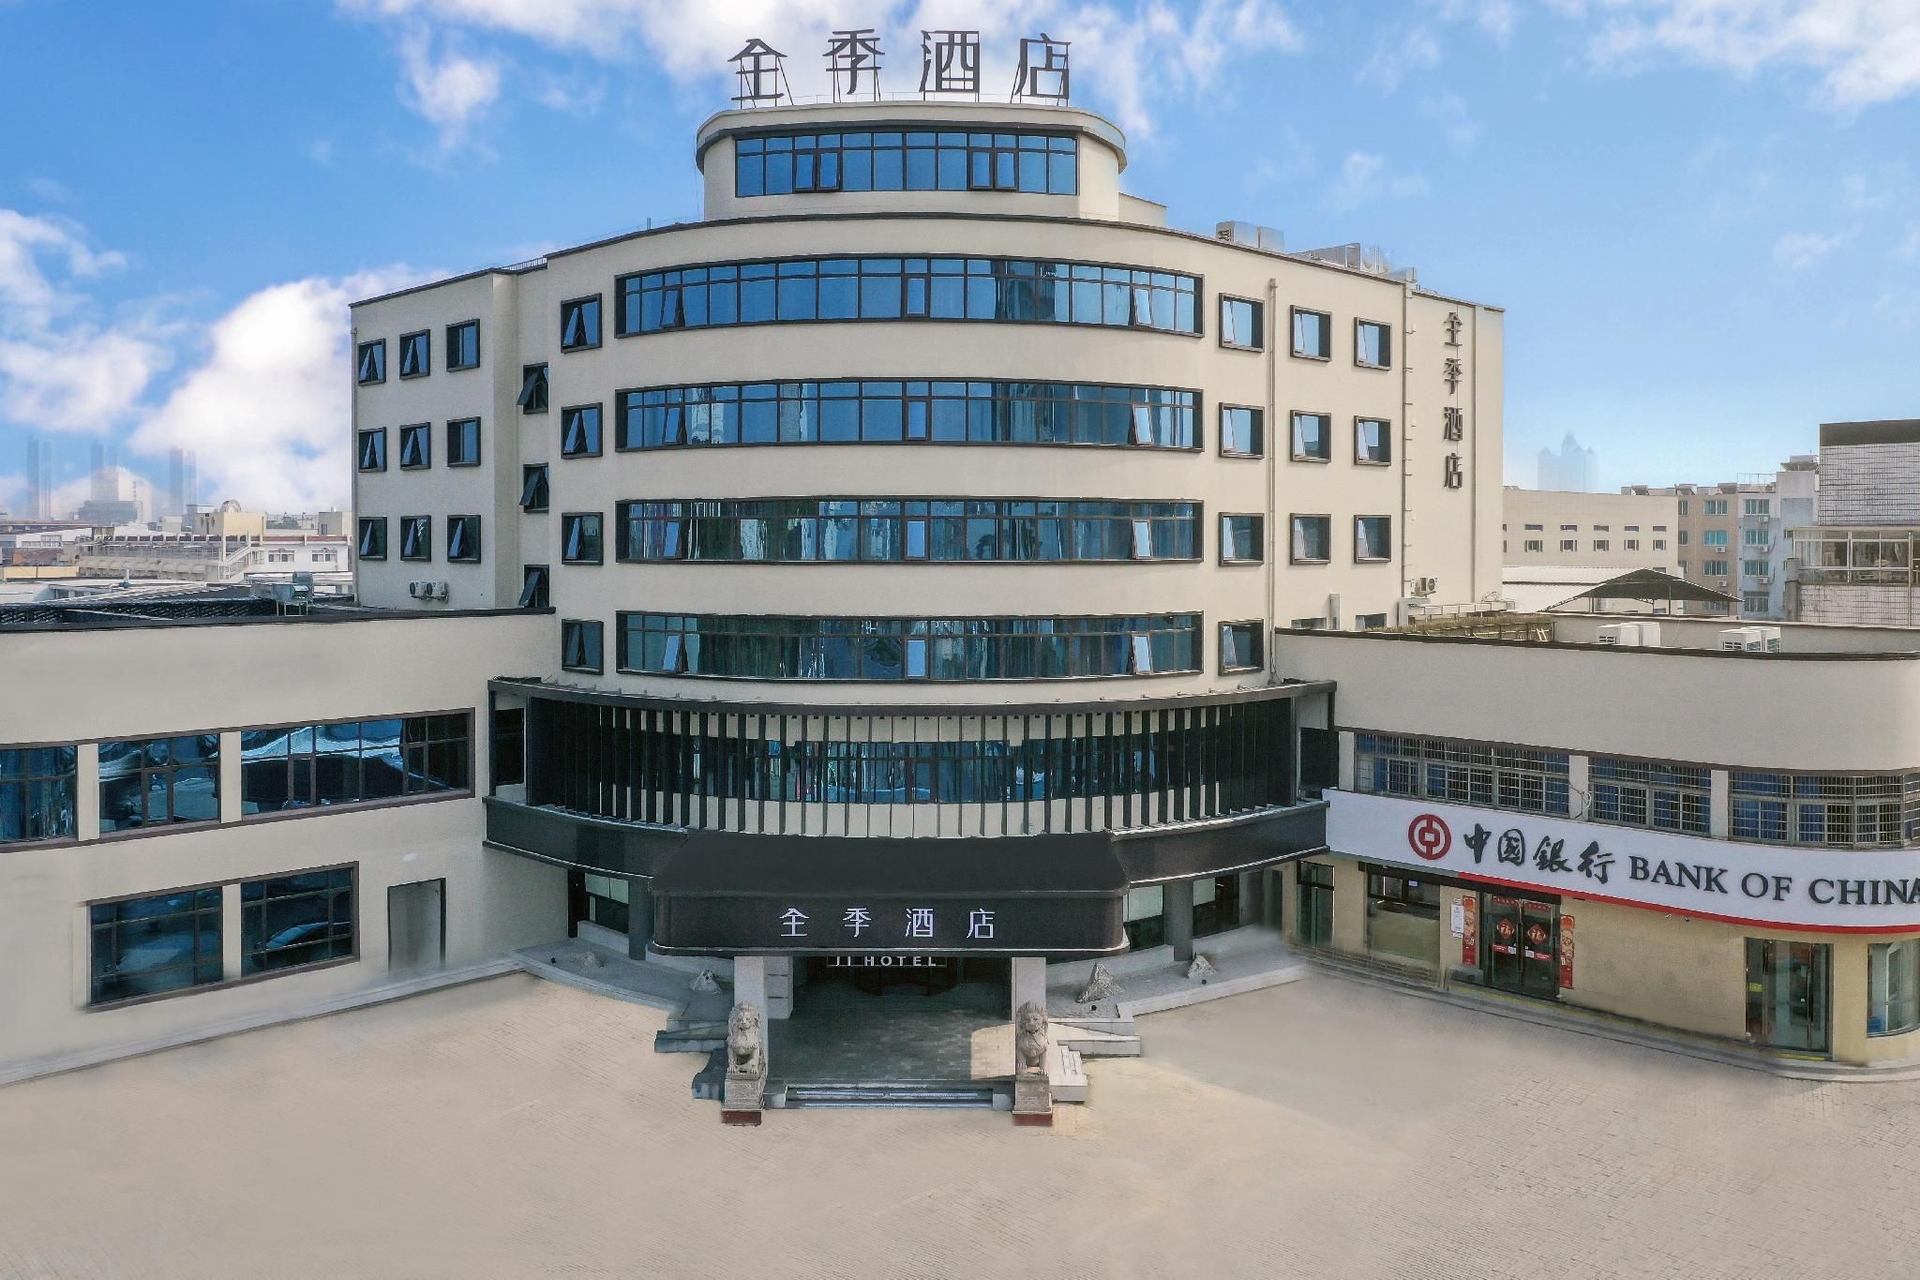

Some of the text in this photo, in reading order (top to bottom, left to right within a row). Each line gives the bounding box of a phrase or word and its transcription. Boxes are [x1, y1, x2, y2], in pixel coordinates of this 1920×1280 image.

[727, 28, 1072, 100] 全季酒店
[1443, 312, 1463, 489] 全季酒店
[1628, 855, 1728, 894] BANK
[1741, 872, 1793, 902] OF
[779, 907, 996, 939] 全季酒店
[835, 956, 937, 967] JI HOTEL
